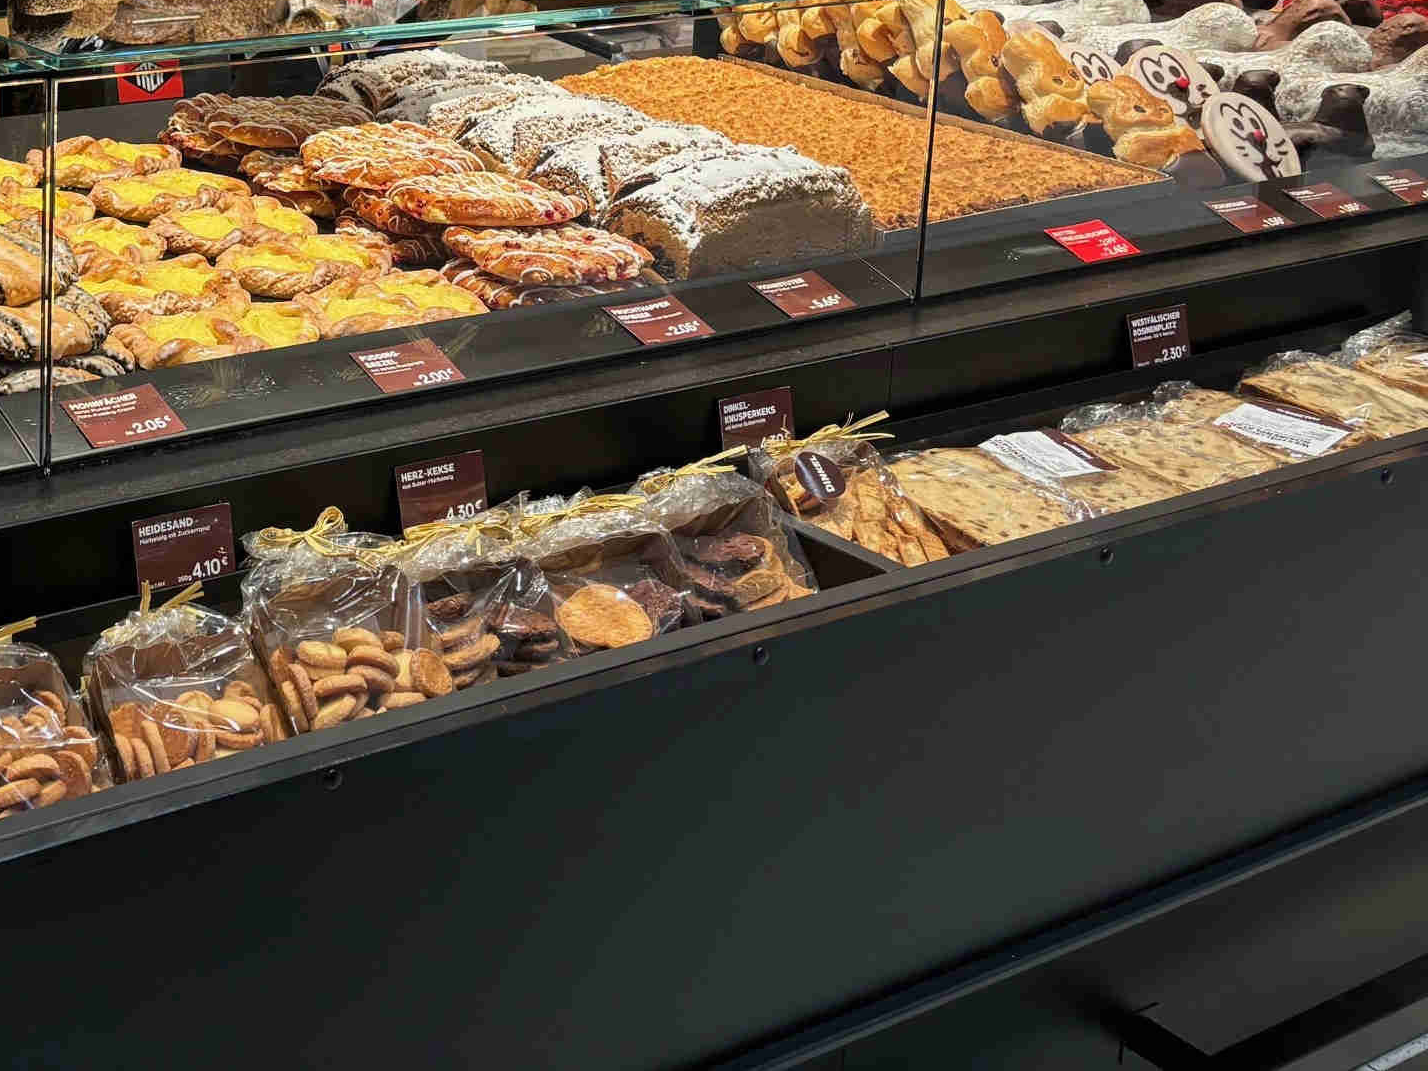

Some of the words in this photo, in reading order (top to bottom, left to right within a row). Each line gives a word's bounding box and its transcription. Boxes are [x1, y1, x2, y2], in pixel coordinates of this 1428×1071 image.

[724, 401, 751, 415] DINKEL-
[724, 405, 776, 425] KNUSPERKEKS
[132, 415, 172, 433] 2.05€
[401, 463, 455, 483] HERZ-KEKSE
[809, 455, 836, 493] DINKEL
[446, 499, 484, 521] 430€
[138, 517, 194, 537] HEIDESAND
[192, 556, 228, 579] 4.10€
